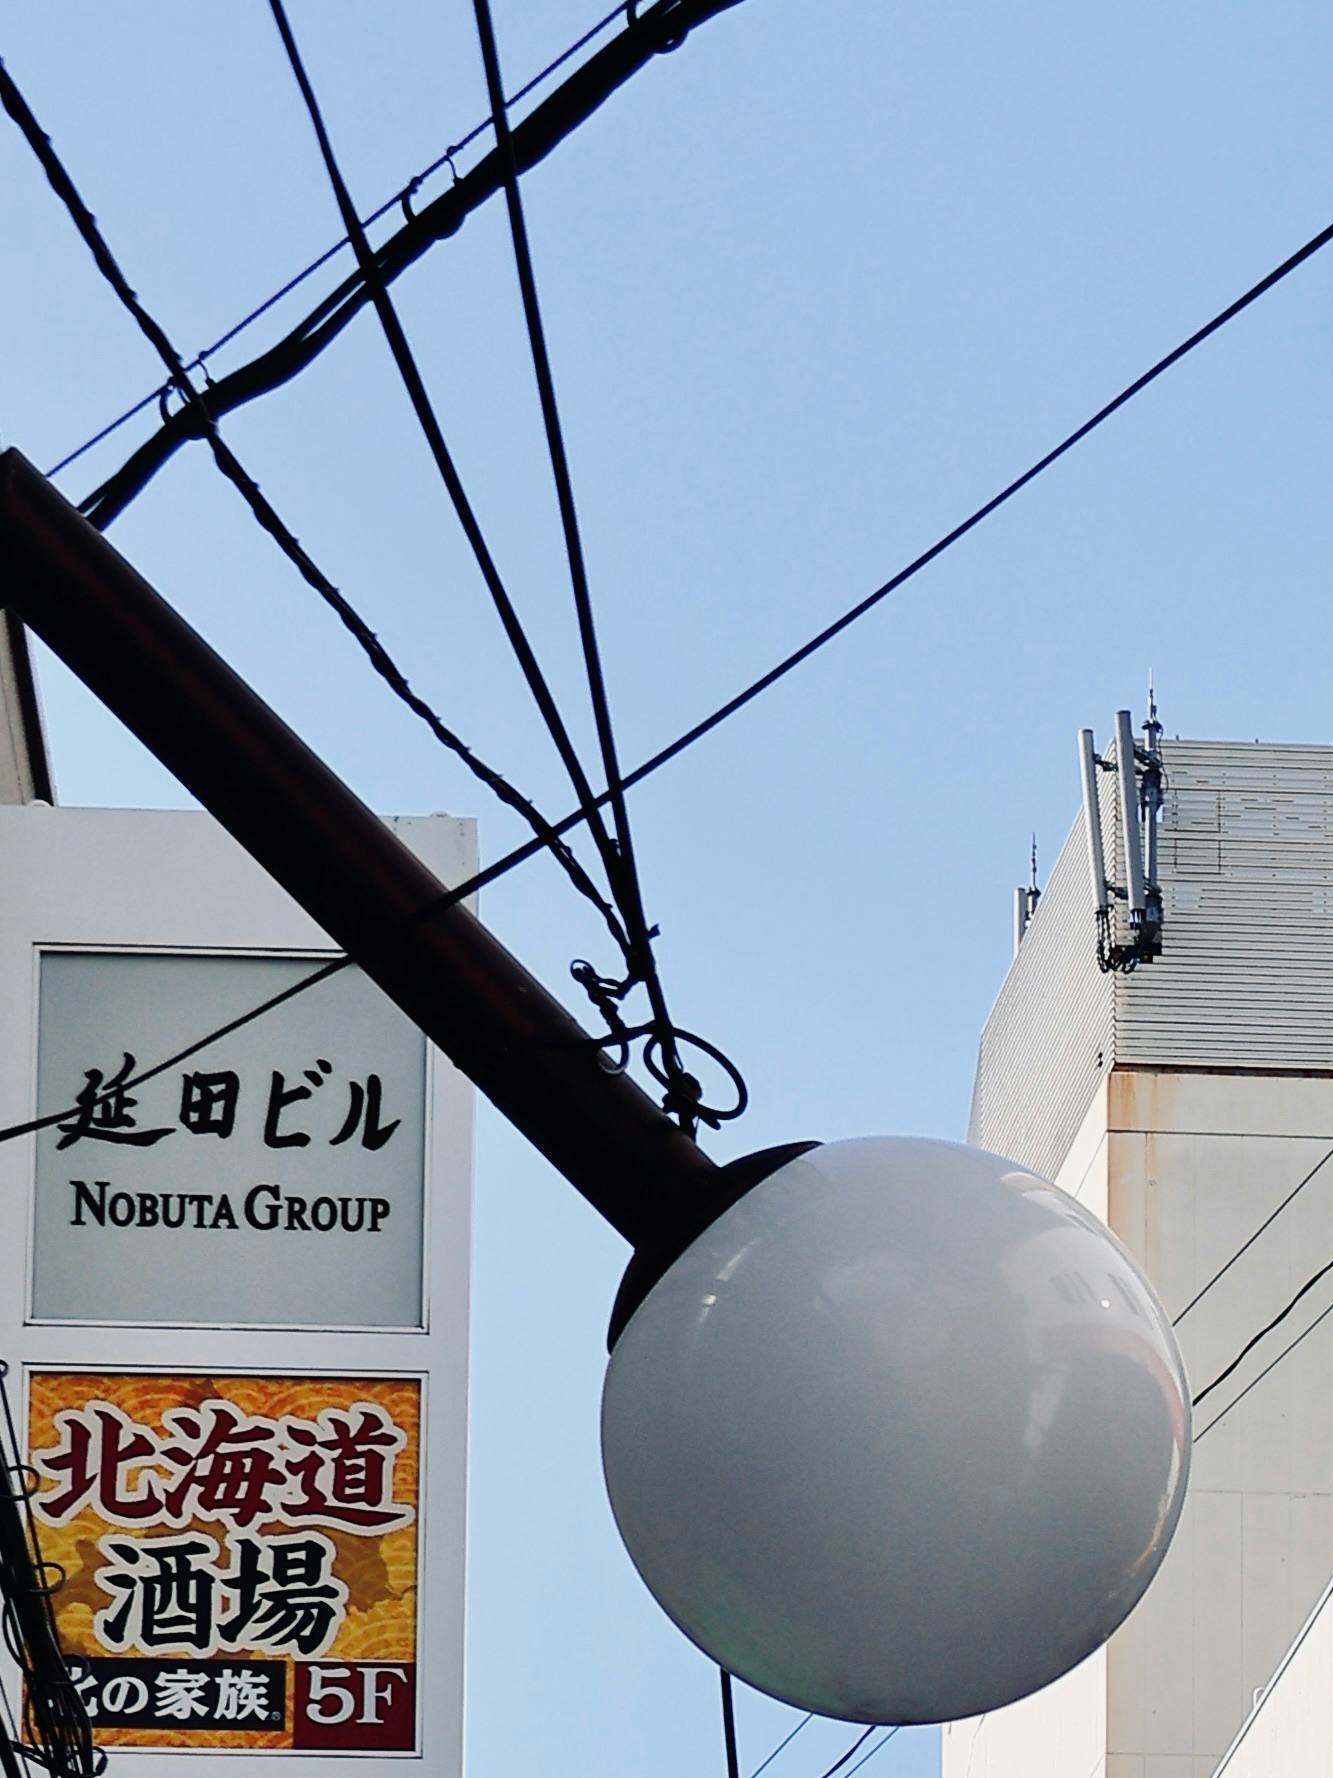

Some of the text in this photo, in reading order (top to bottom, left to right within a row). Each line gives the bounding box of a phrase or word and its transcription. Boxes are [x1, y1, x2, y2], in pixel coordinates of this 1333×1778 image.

[58, 1051, 402, 1150] 延田ビル
[70, 1180, 390, 1232] NOBUTA GROUP
[38, 1405, 408, 1527] 北海道
[103, 1537, 342, 1656] 酒場
[305, 1666, 408, 1724] 5F
